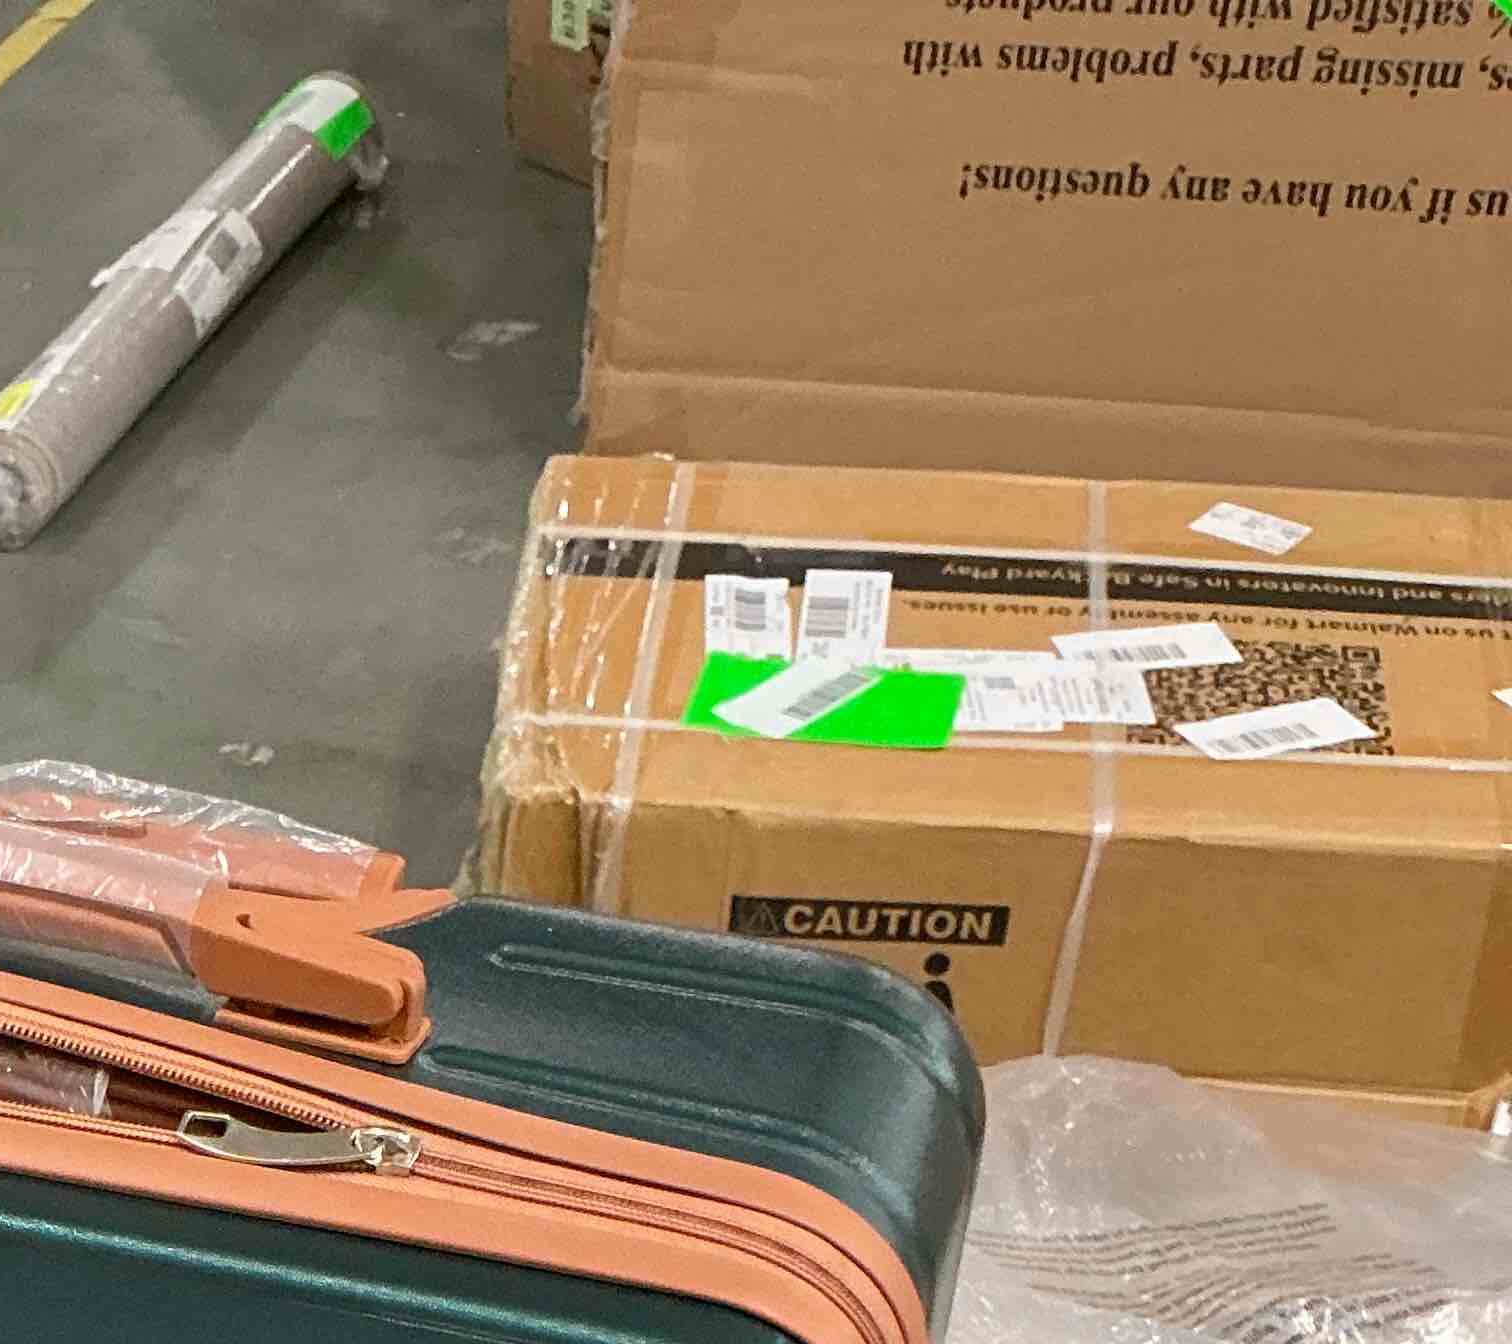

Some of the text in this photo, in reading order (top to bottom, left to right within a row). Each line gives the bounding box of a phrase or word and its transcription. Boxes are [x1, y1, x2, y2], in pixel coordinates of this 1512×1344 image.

[903, 39, 984, 77] with
[997, 39, 1179, 83] problems
[1190, 44, 1304, 88] parts,
[1313, 47, 1464, 99] missing
[959, 161, 1510, 225] us if you have any questions!
[784, 904, 994, 941] CAUTION
